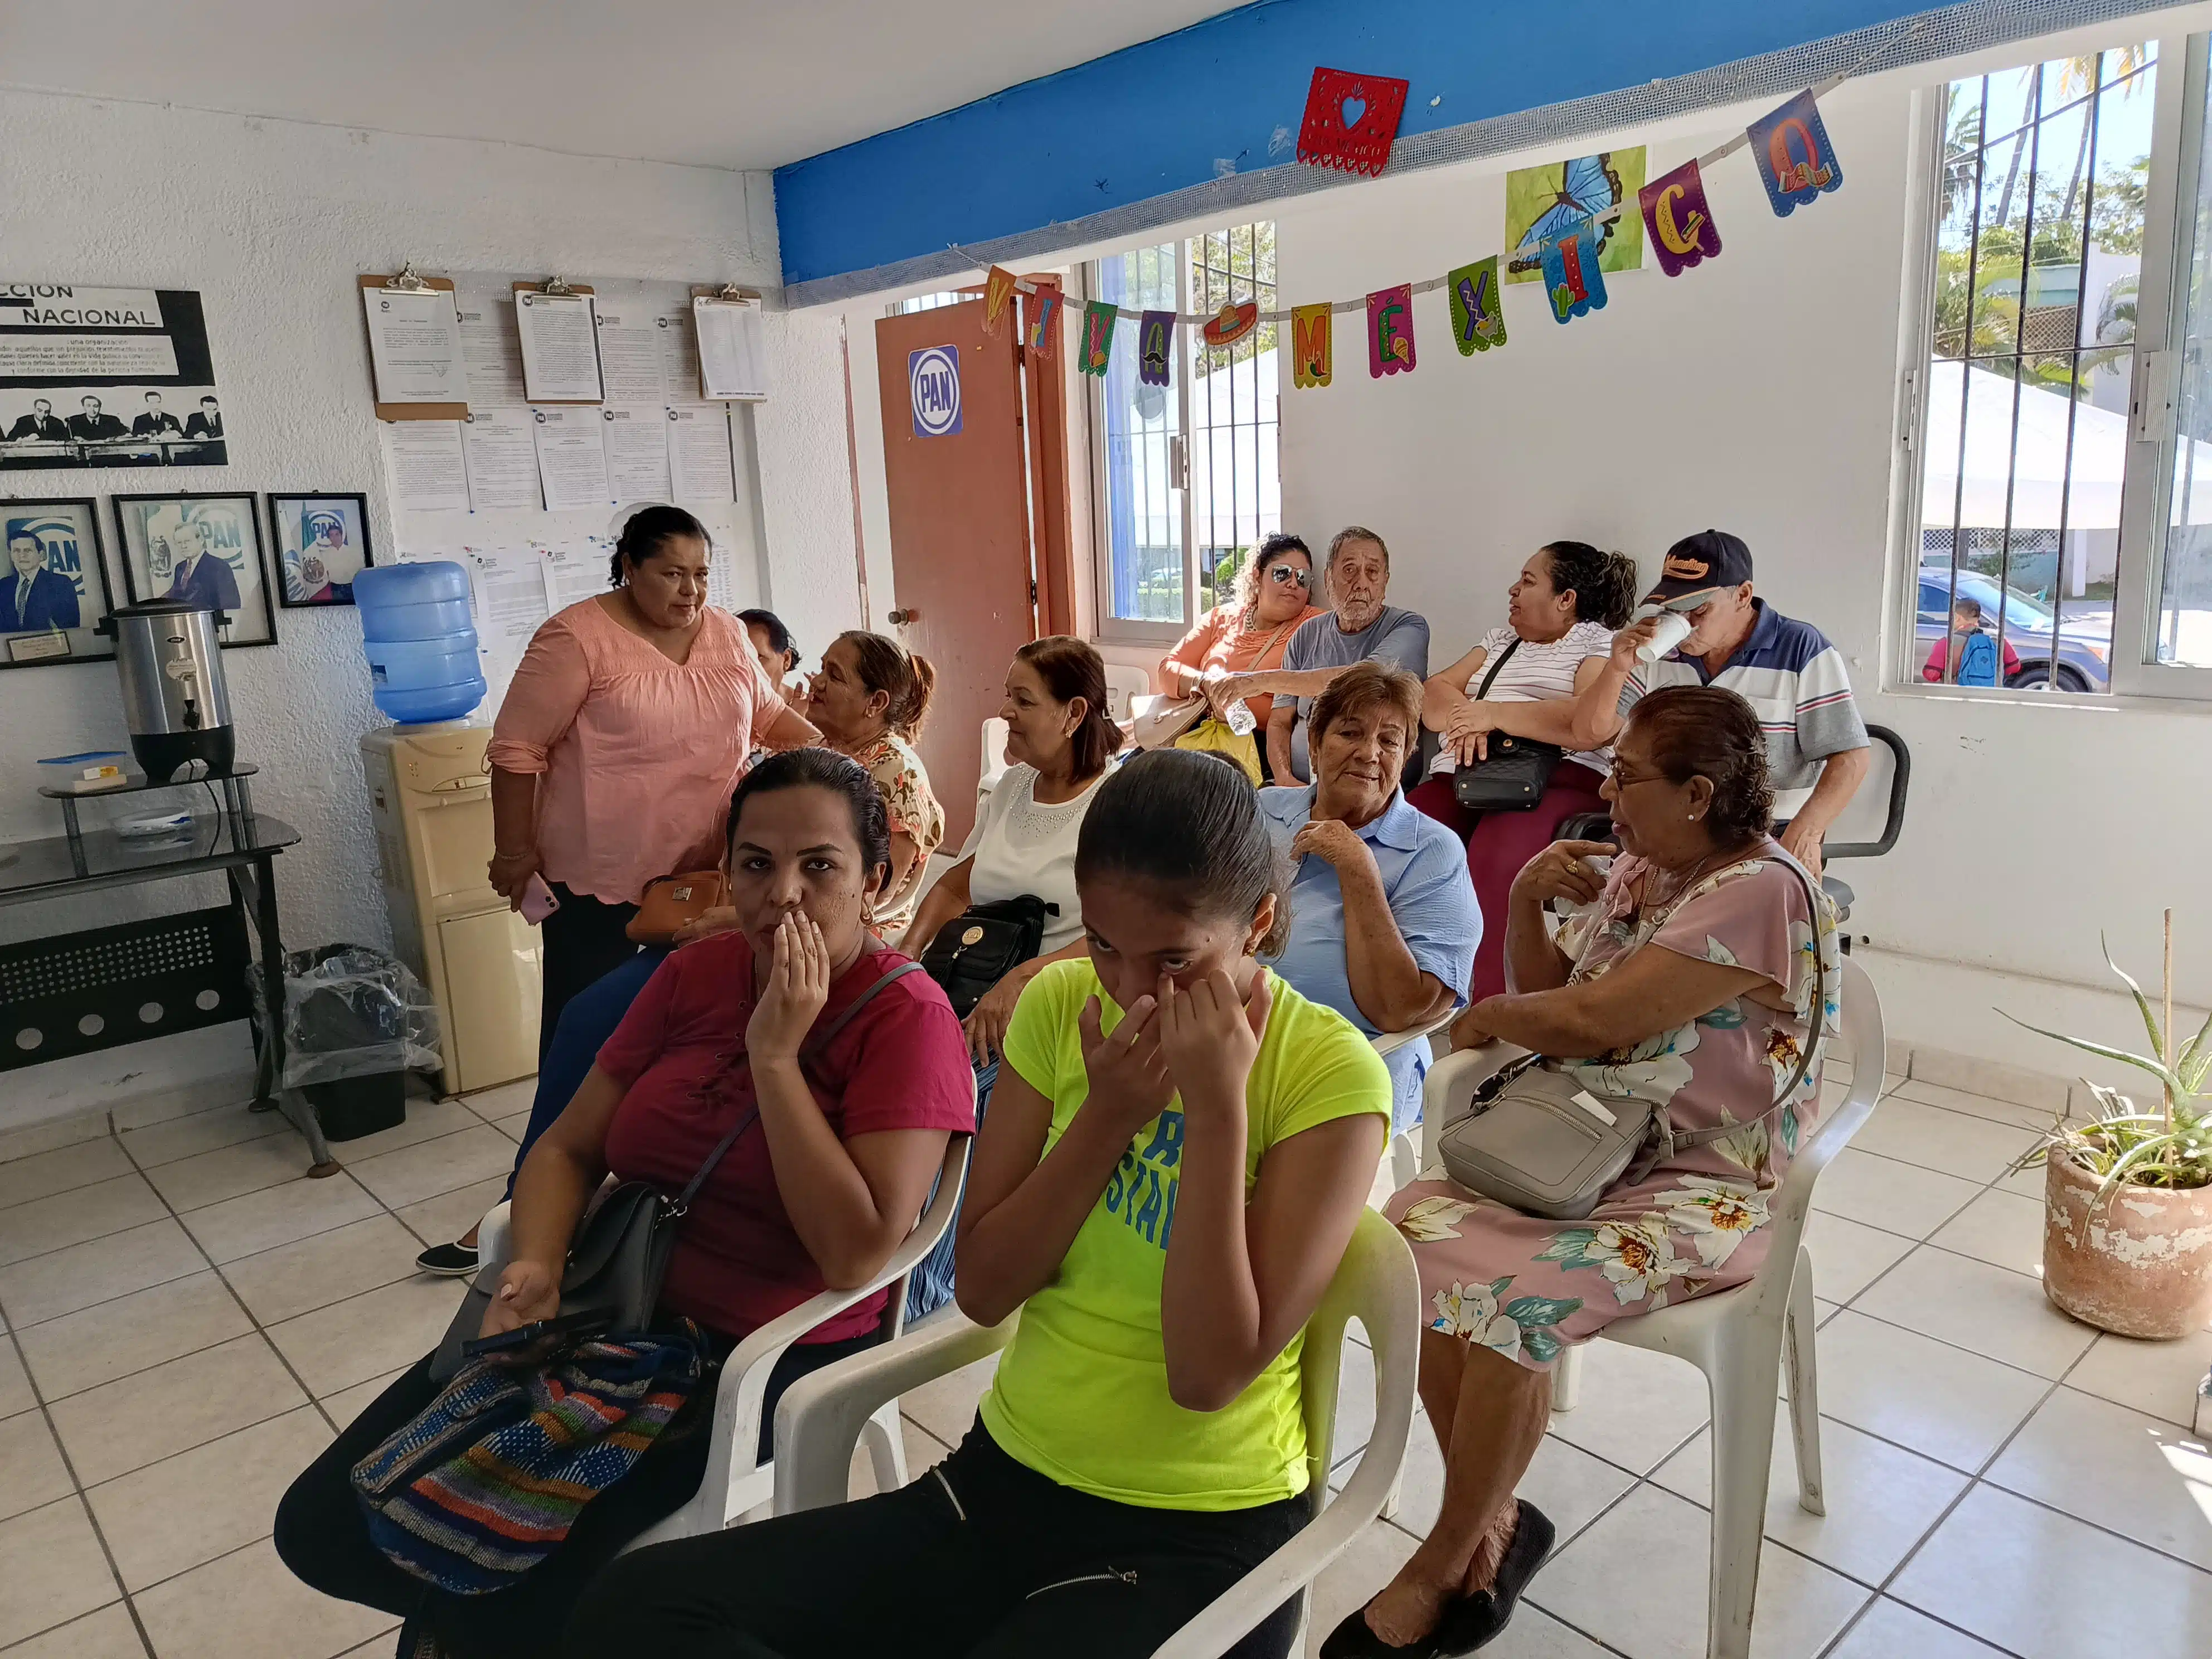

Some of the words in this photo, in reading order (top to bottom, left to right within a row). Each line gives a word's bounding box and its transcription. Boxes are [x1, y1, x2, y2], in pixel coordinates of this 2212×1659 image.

[22, 309, 156, 324] NACIONAL
[920, 371, 951, 413] PAN
[199, 519, 241, 549] PAN
[48, 540, 82, 572] AN
